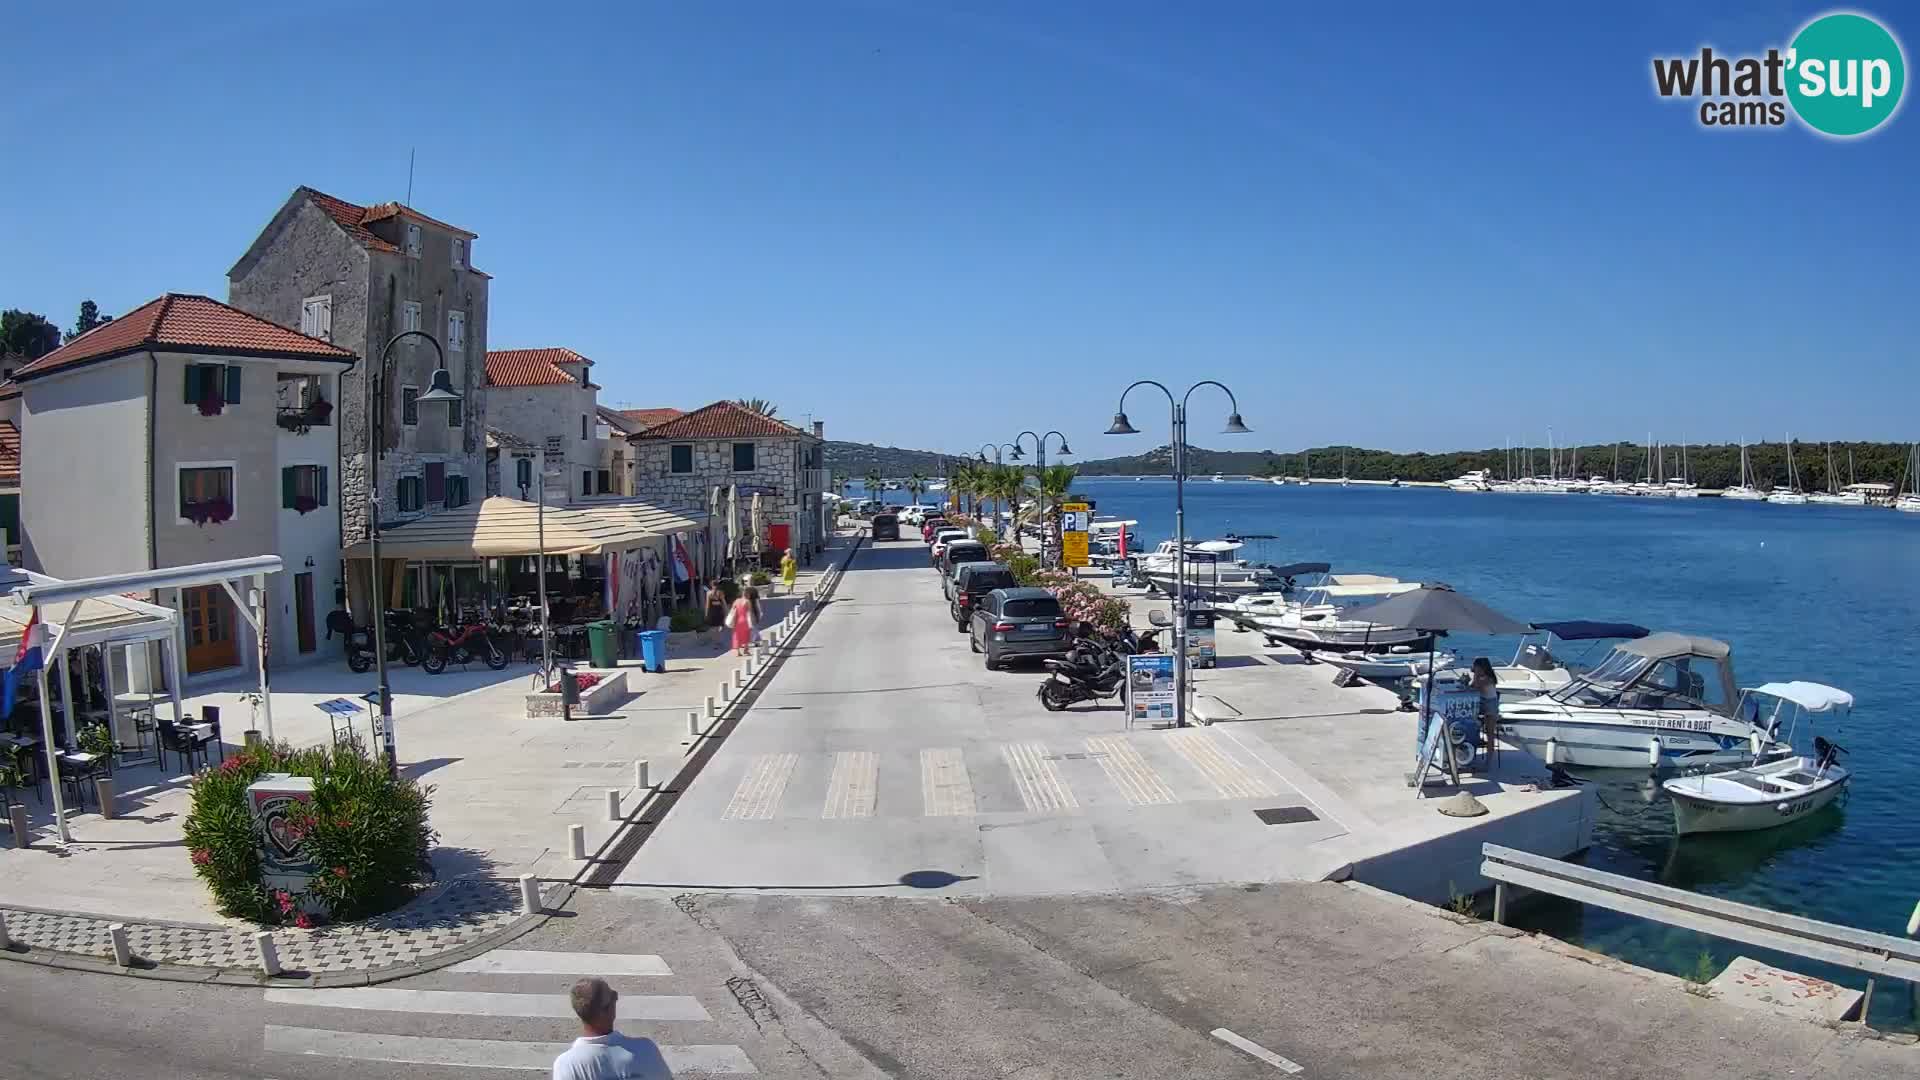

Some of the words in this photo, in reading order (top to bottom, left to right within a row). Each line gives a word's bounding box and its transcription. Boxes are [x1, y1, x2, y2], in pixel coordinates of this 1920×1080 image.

[1667, 720, 1686, 729] RENT
[1687, 720, 1692, 729] A
[1693, 720, 1712, 731] BOAT
